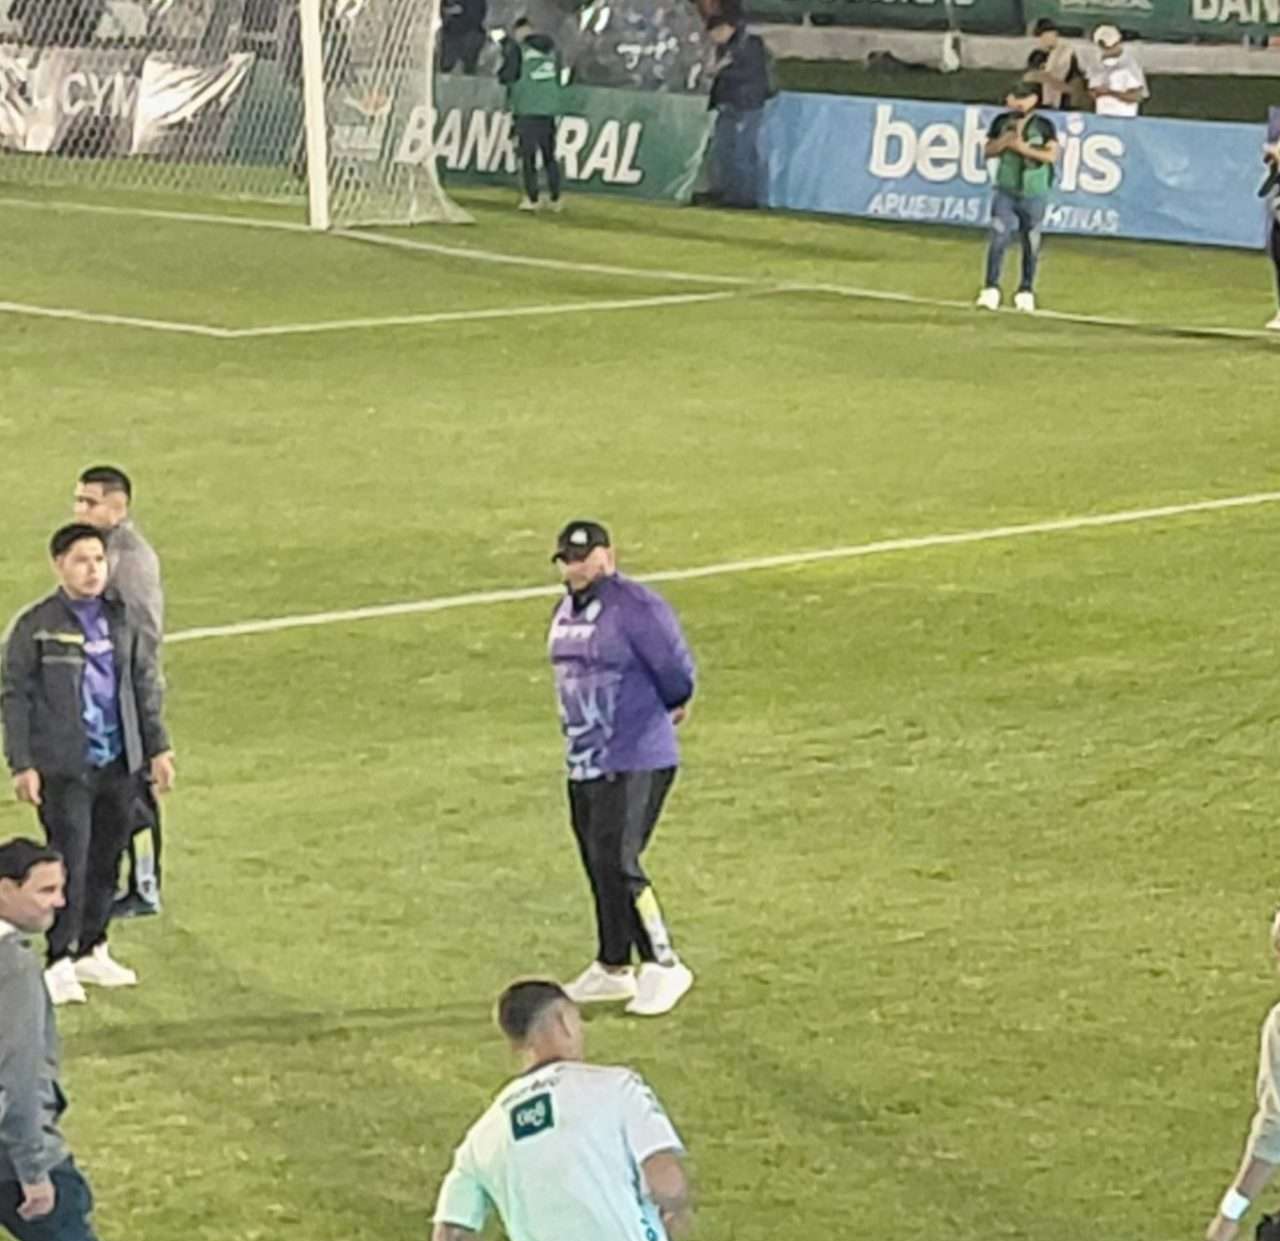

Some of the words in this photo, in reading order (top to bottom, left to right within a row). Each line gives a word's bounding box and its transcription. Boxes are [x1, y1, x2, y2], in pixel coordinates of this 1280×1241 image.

[393, 106, 643, 184] BANRRAL
[867, 104, 1125, 194] betis
[867, 191, 982, 222] APUESTAS
